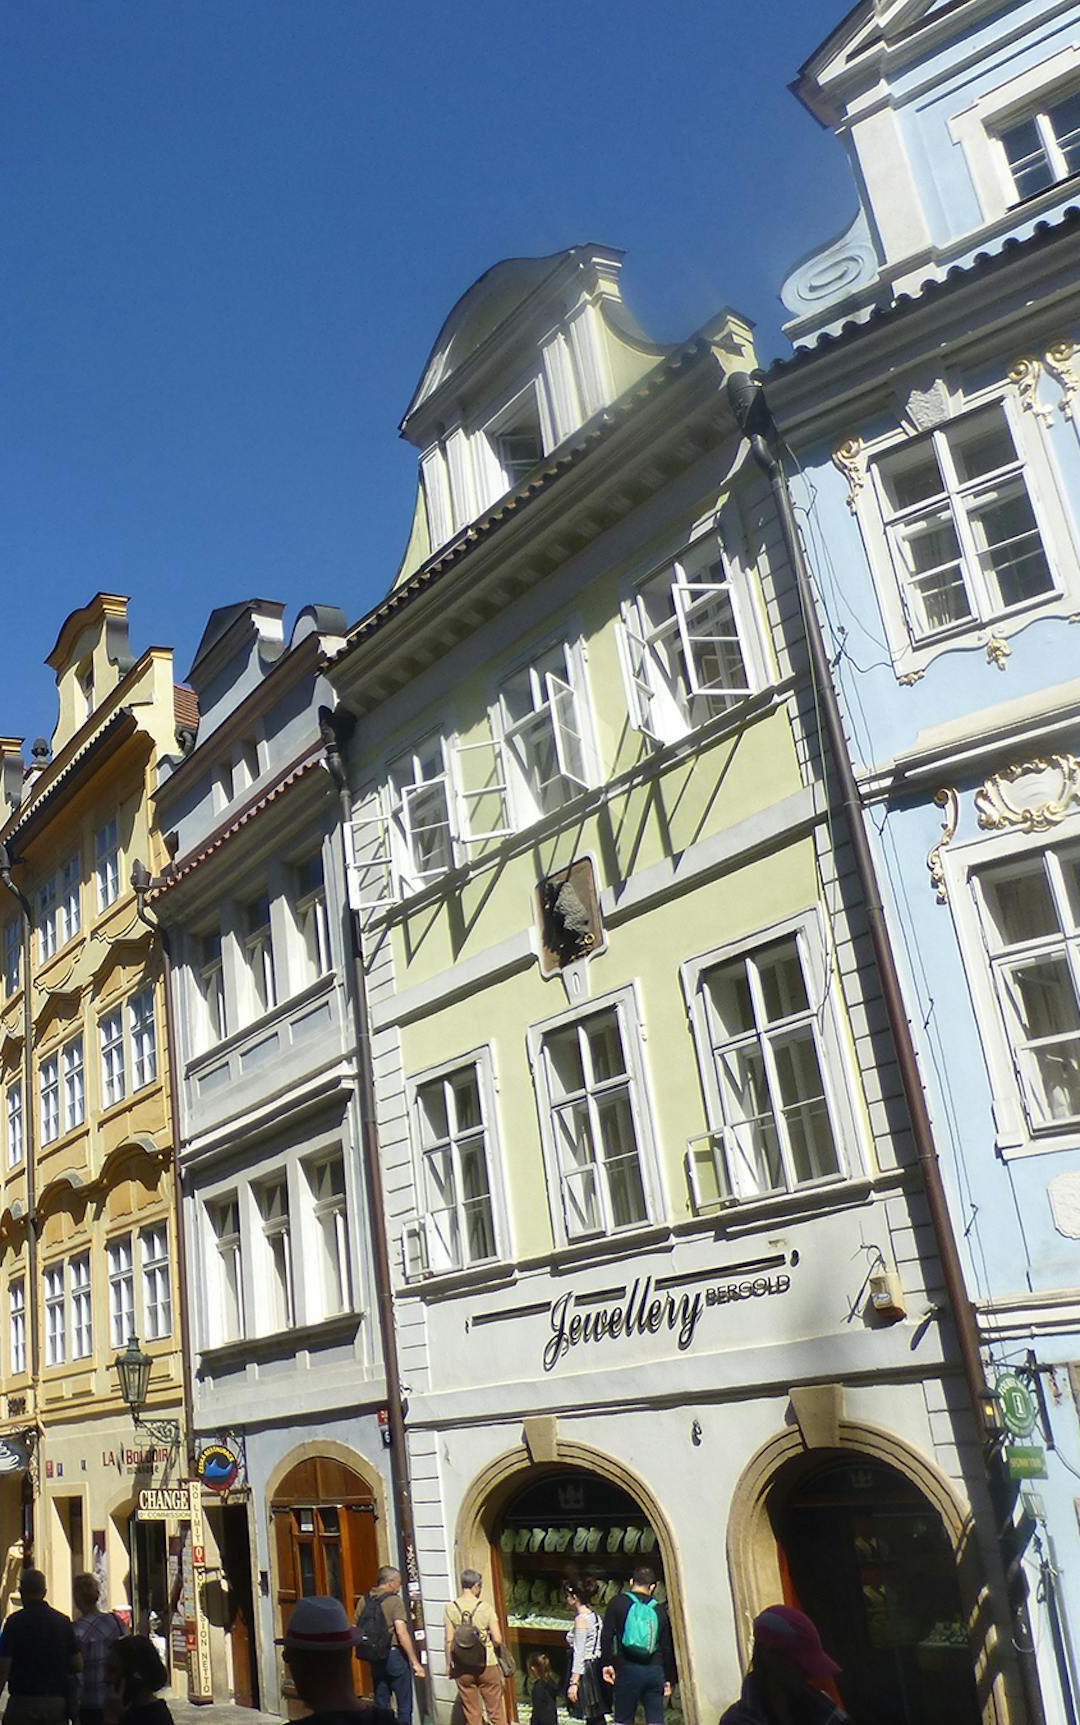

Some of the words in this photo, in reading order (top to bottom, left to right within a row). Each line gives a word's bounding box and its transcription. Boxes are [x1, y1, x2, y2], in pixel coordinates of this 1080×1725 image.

[543, 1275, 704, 1372] Jewellery
[706, 1274, 791, 1307] BERGOLD
[102, 1451, 116, 1467] LA
[139, 1489, 189, 1510] CHANGE
[192, 1484, 199, 1499] NO
[193, 1504, 201, 1544] LIMIT
[202, 1653, 210, 1693] NETTO
